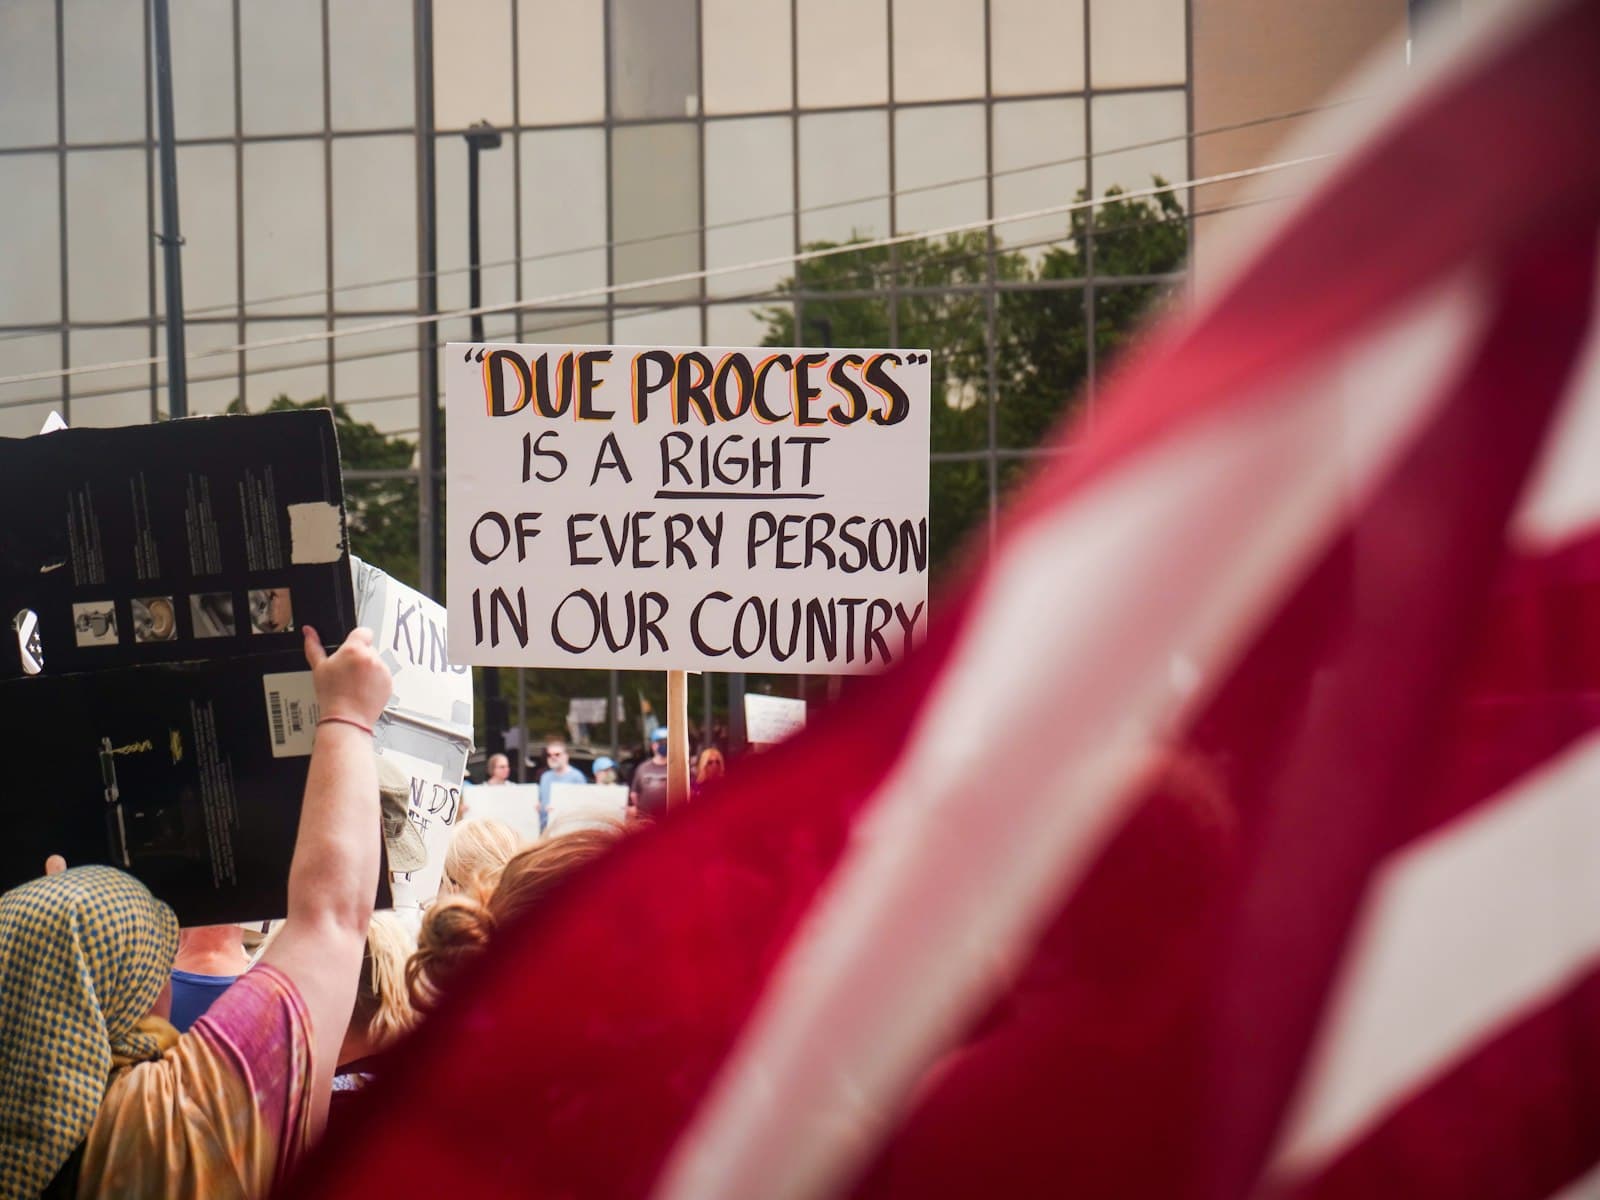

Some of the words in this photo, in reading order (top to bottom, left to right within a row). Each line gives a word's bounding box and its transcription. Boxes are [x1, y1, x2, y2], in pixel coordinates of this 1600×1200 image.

[522, 430, 568, 483] IS
[590, 432, 633, 486] A
[659, 431, 831, 491] RIGHT
[469, 511, 543, 566] OF
[567, 511, 724, 570] EVERY
[747, 511, 927, 574] PERSON
[393, 598, 467, 675] KiN
[472, 586, 529, 649] IN
[551, 588, 669, 656] OUR
[689, 591, 925, 665] COUNTRY
